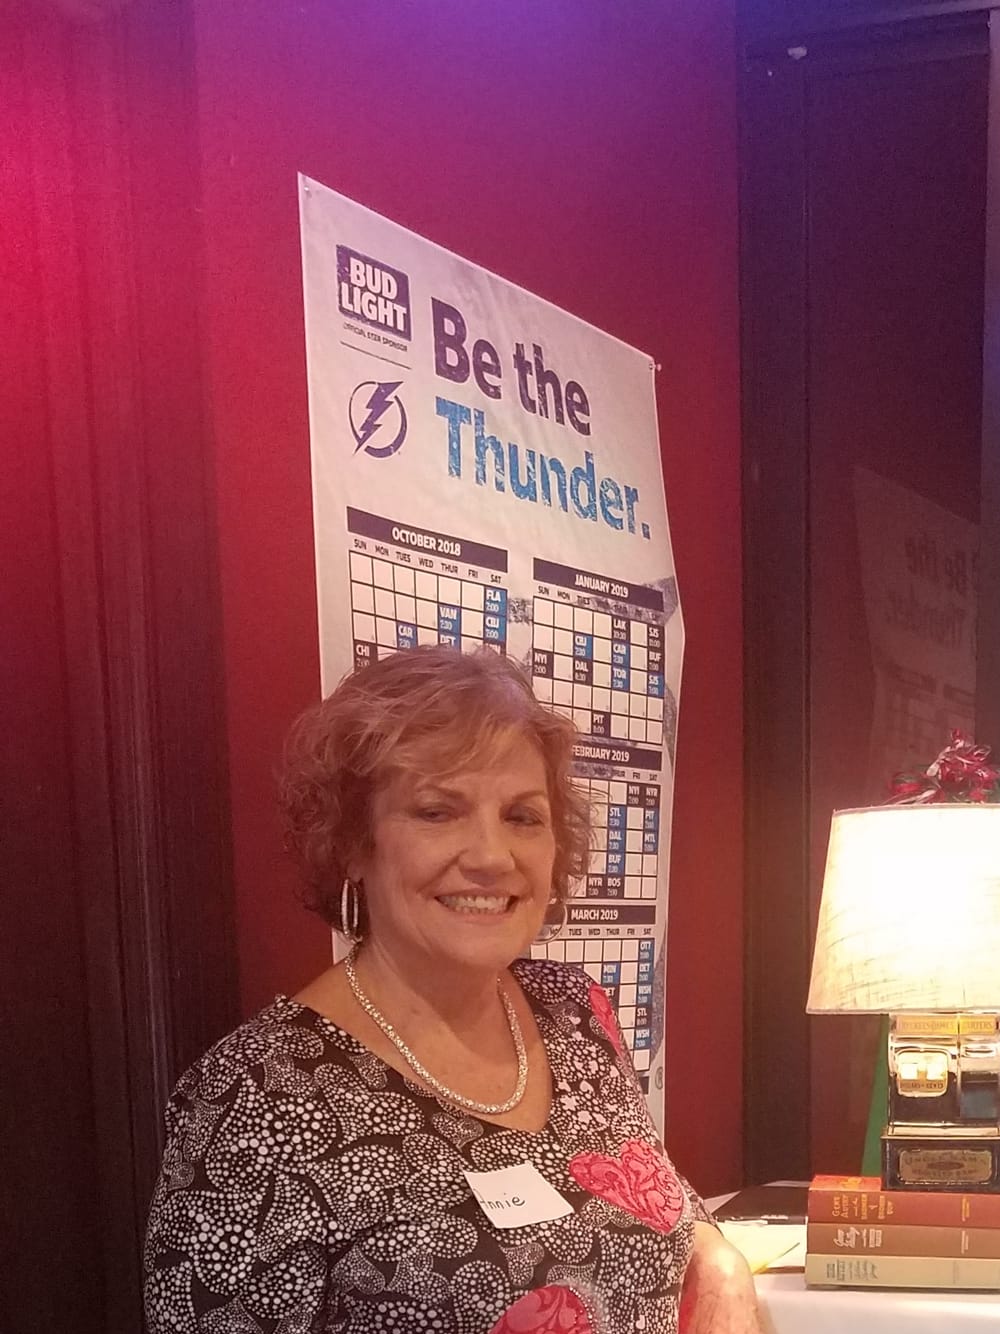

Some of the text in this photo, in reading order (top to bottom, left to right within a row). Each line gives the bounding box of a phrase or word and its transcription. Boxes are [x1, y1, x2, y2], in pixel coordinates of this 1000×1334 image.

[350, 257, 398, 299] BUD
[341, 282, 407, 332] LIGHT
[431, 296, 591, 436] Be the
[435, 396, 651, 540] Thunder.
[392, 527, 461, 556] OCTOBER 2018
[353, 538, 502, 584] SUN MON TUES WED THUR FRI SAT
[575, 573, 629, 598] JANUARY 2019
[538, 586, 550, 595] SUN
[557, 591, 570, 600] MON
[440, 607, 457, 620] VAN
[399, 625, 414, 639] CAR
[355, 644, 370, 657] CHI
[534, 652, 547, 665] NYI
[575, 660, 588, 672] DAL
[593, 713, 604, 724] PIT
[571, 744, 630, 762] FEBRUARY 2019
[609, 807, 621, 817] STL
[607, 877, 621, 887] BOS
[571, 908, 619, 921] MARCH 2019
[568, 928, 582, 936] TUES
[588, 928, 601, 936] WED
[606, 928, 620, 936] THUR
